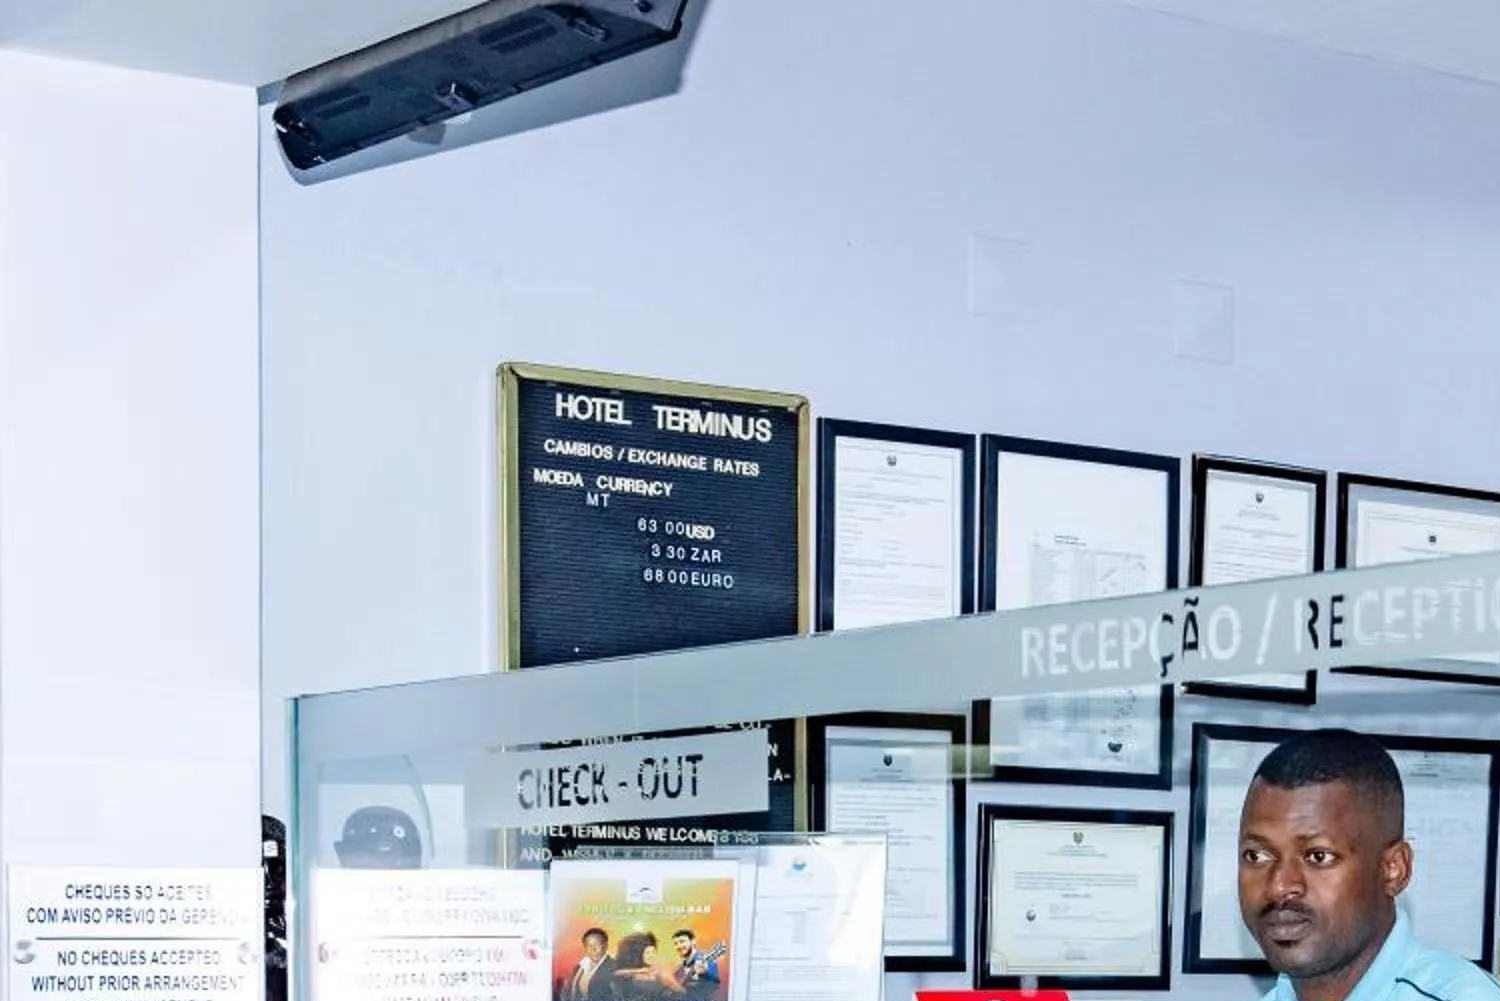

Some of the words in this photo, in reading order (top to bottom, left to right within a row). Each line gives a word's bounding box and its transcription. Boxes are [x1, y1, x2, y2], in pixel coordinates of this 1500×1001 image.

[554, 393, 633, 426] HOTEL
[652, 404, 773, 443] TERMINUS
[543, 439, 613, 460] CAMBIOS
[628, 447, 707, 471] EXCHANGE
[713, 458, 760, 477] RATES
[532, 467, 584, 488] MOEDA
[596, 475, 673, 497] CURRENCY
[691, 547, 722, 563] ZAR
[1020, 595, 1243, 680] RECEPÇÃO
[1255, 593, 1279, 667] /
[517, 763, 610, 811] CHECK
[637, 753, 704, 802] OUT
[571, 826, 641, 842] TERMINUS
[519, 847, 552, 863] AND
[65, 884, 131, 901] CHEQUES
[157, 884, 213, 901] ACETES
[26, 907, 59, 924] COM
[62, 907, 102, 924] AVISO
[105, 906, 156, 925] PRÉVIO
[159, 907, 177, 925] DA
[57, 950, 78, 966] NO
[82, 950, 147, 966] CHEQUES
[151, 950, 221, 966] ACCEPTED
[31, 975, 95, 992] WITHOUT
[99, 975, 141, 991] PRIOR
[144, 974, 245, 991] ARRANGEMENT
